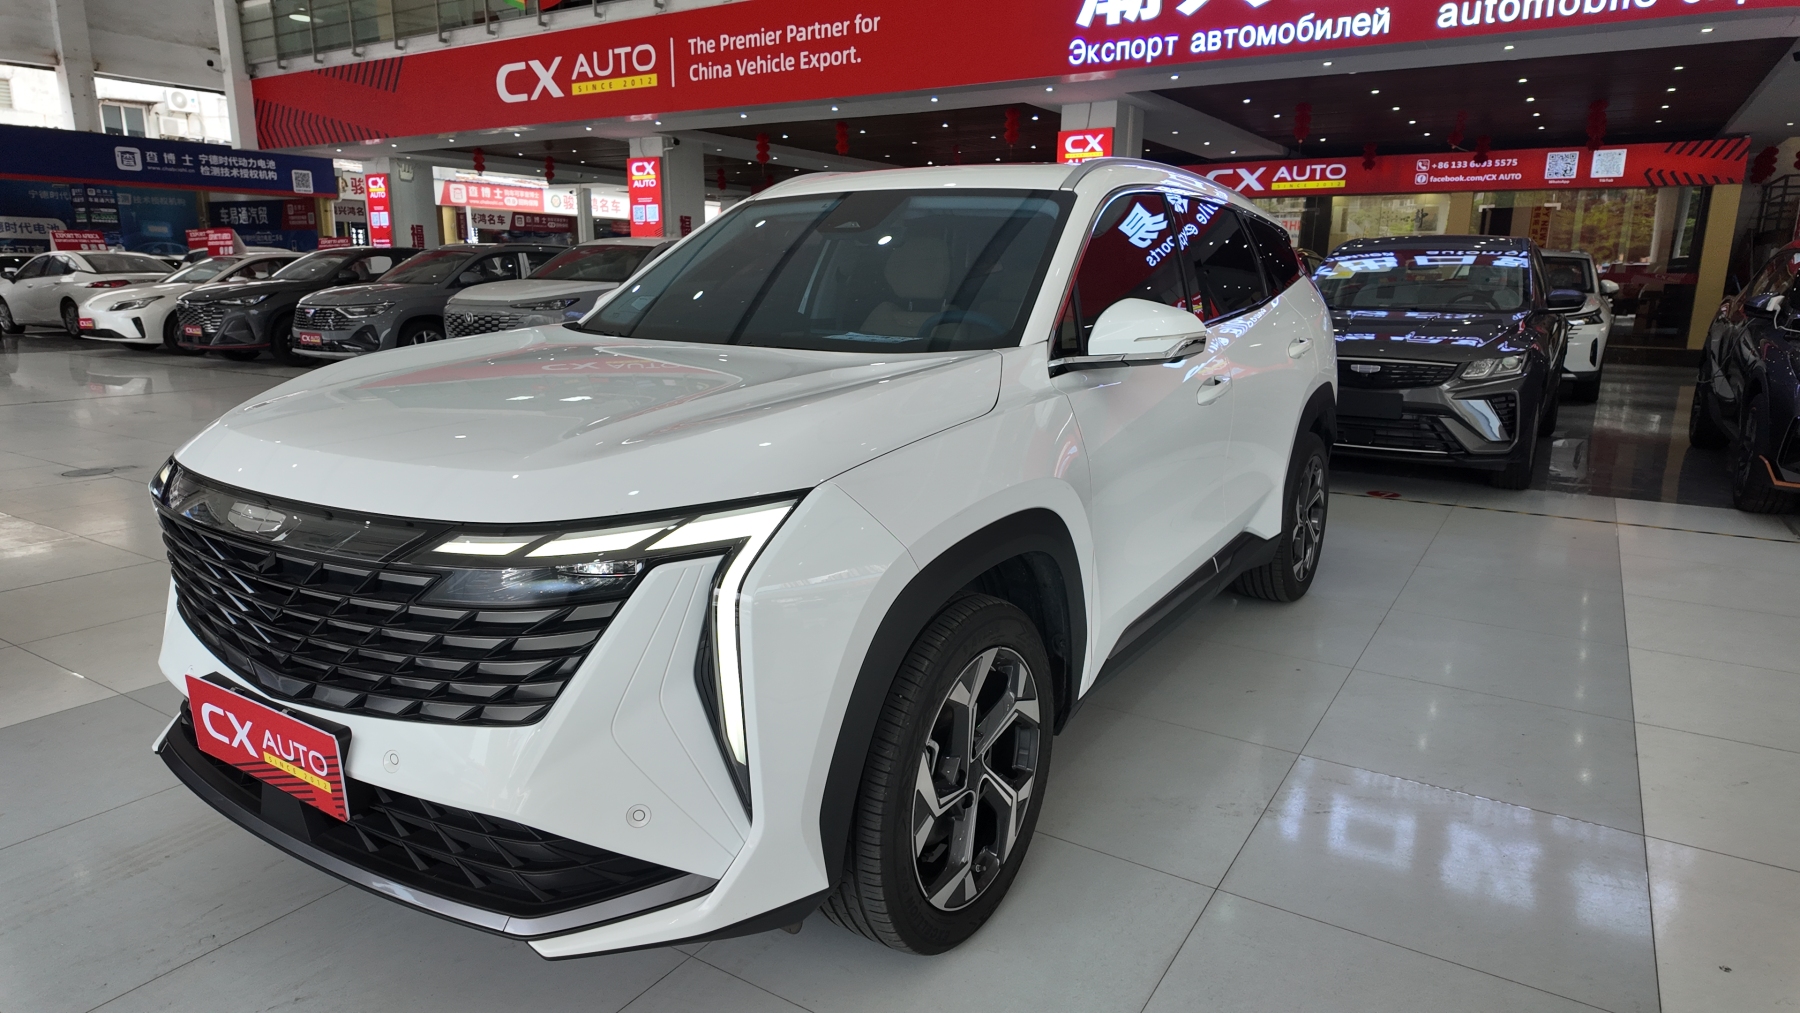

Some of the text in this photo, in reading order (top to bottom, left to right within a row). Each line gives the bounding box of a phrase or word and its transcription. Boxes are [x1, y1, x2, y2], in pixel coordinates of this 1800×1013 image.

[1436, 0, 1657, 28] automo
[688, 13, 881, 56] The Premier Partner for
[1068, 36, 1180, 66] Экспорт
[1190, 6, 1392, 54] автомобилей
[689, 46, 862, 82] China Vehicle Export.
[496, 44, 656, 103] CX AUTO
[578, 76, 653, 93] SINCE 2012
[1065, 133, 1104, 153] CX
[145, 151, 194, 166] 查博士
[198, 154, 277, 170] 宁德时代动力电池
[1431, 161, 1449, 169] +86
[1451, 160, 1468, 169] 133
[1494, 158, 1518, 167] 5575
[200, 165, 278, 181] 检测技术授权机构
[631, 161, 656, 176] CX
[1272, 163, 1347, 181] AUTO
[1498, 173, 1522, 181] AUTO
[367, 176, 386, 189] CX
[632, 179, 657, 188] AUTO
[369, 191, 387, 199] AUTO
[219, 206, 269, 225] 车易通汽贸
[201, 702, 259, 759] CX
[262, 729, 328, 777] AUTO
[268, 755, 328, 790] SINCE 2012
